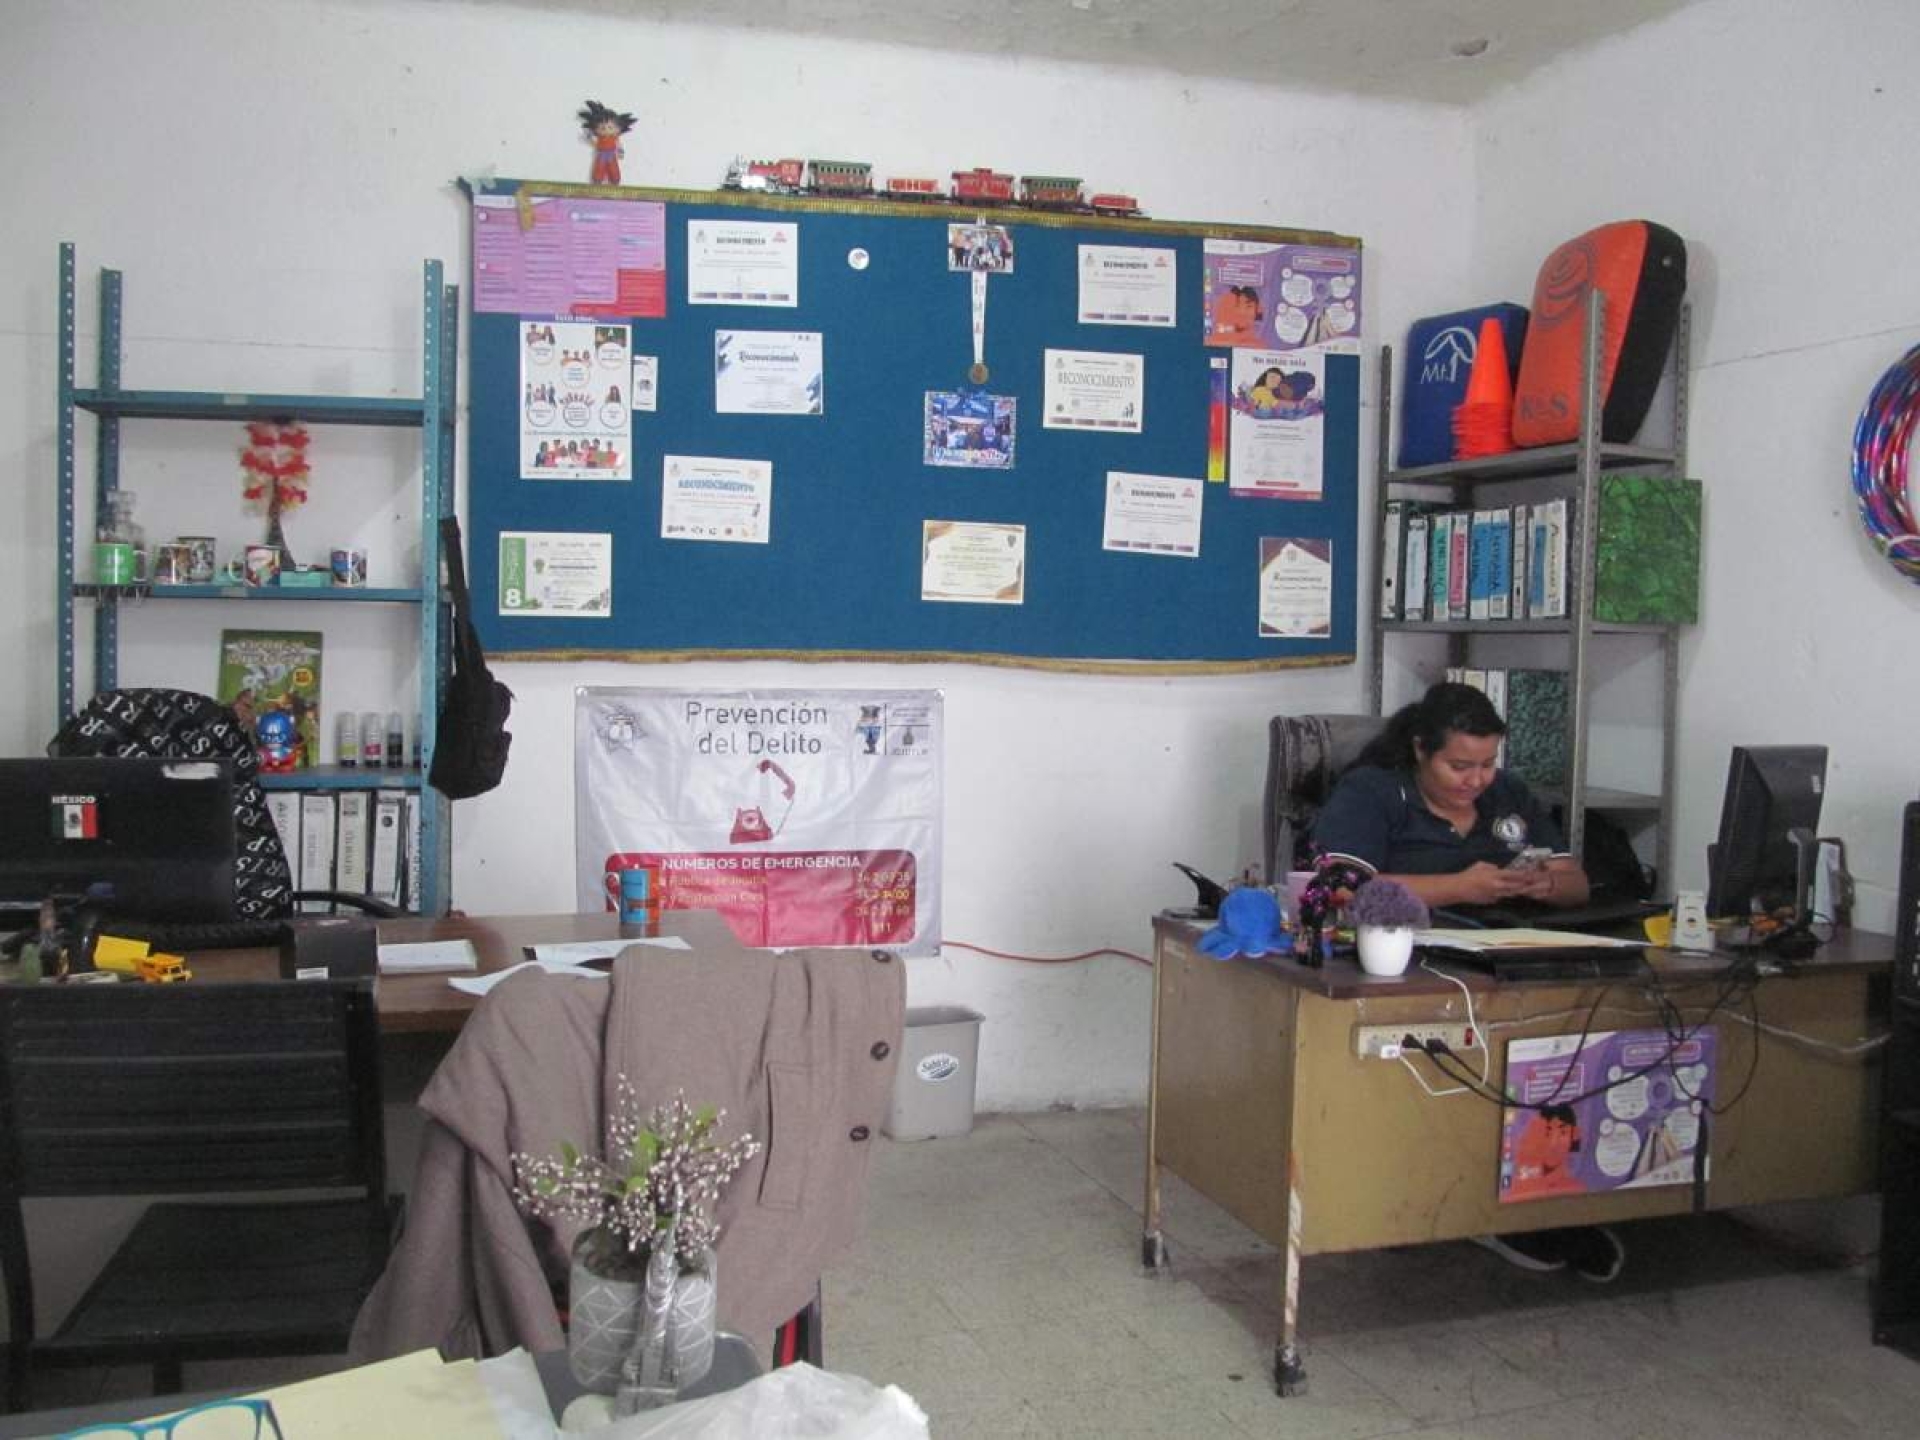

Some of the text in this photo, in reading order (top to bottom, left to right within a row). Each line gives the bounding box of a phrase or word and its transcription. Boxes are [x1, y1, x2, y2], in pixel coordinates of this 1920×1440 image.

[686, 701, 828, 724] Prevención
[699, 731, 822, 754] del Delito
[742, 857, 762, 870] DE
[764, 855, 861, 870] EMERGENCIA
